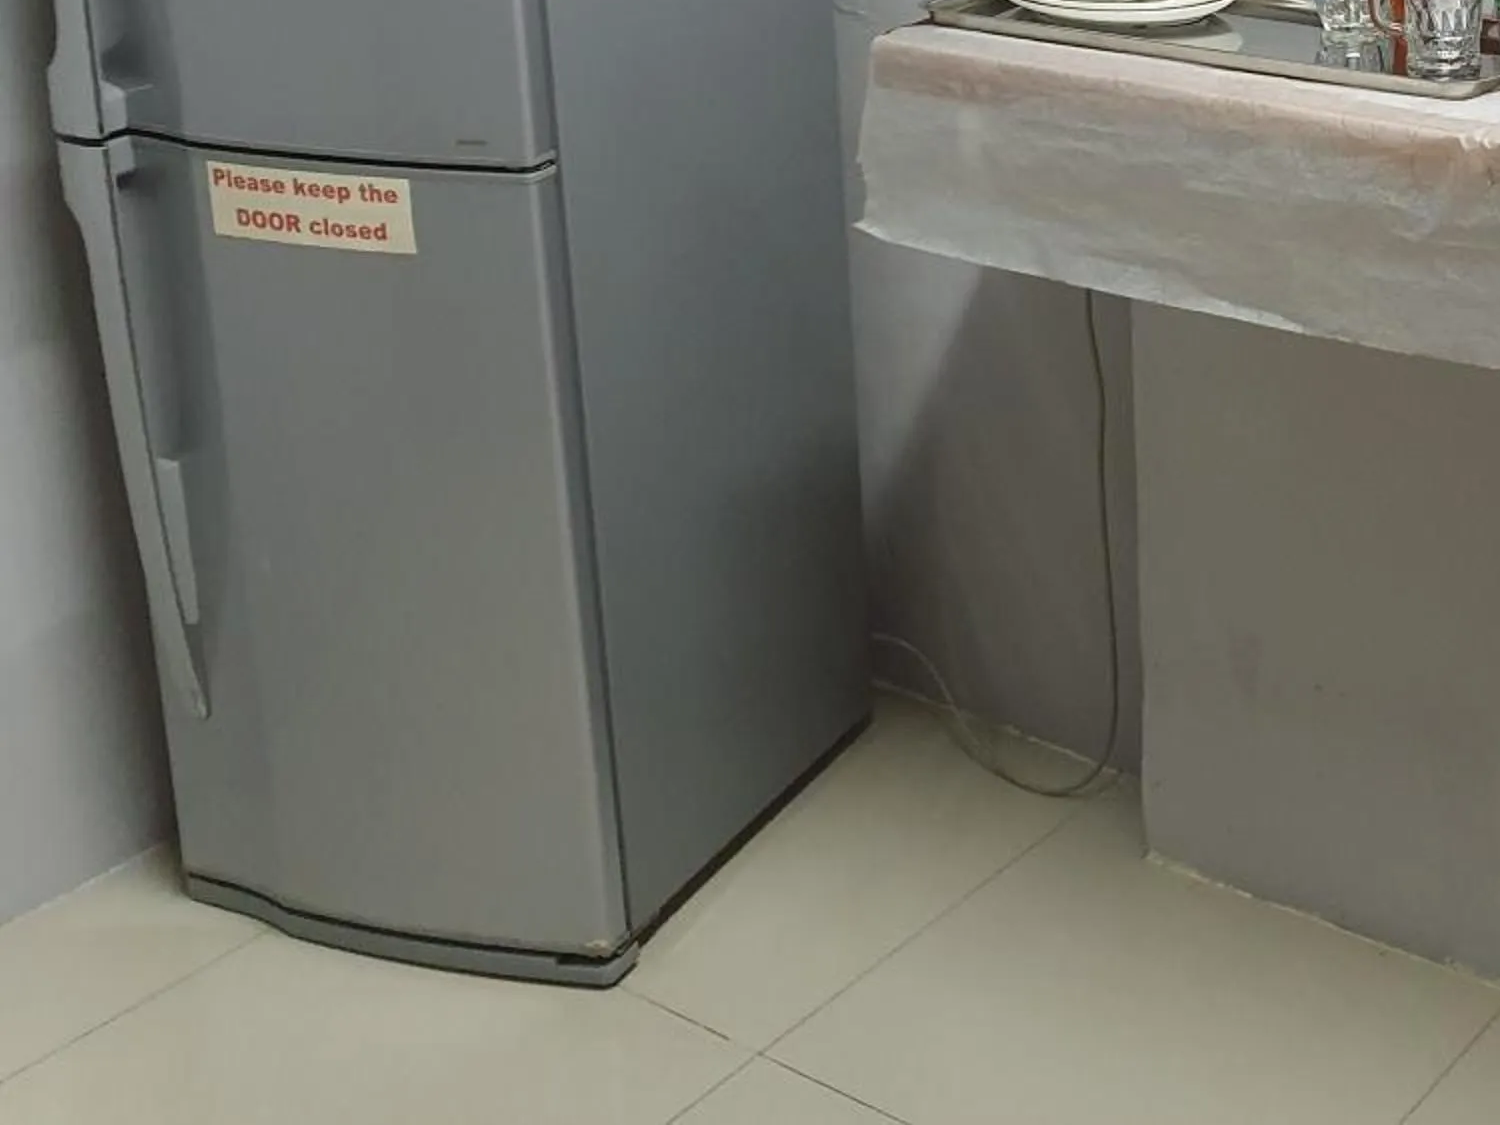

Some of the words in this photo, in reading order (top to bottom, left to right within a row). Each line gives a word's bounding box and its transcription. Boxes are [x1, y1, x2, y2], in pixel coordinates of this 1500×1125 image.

[212, 168, 285, 194] Please
[293, 178, 351, 203] keep
[358, 182, 399, 204] the
[236, 207, 301, 233] DOOR
[309, 218, 388, 241] closed
